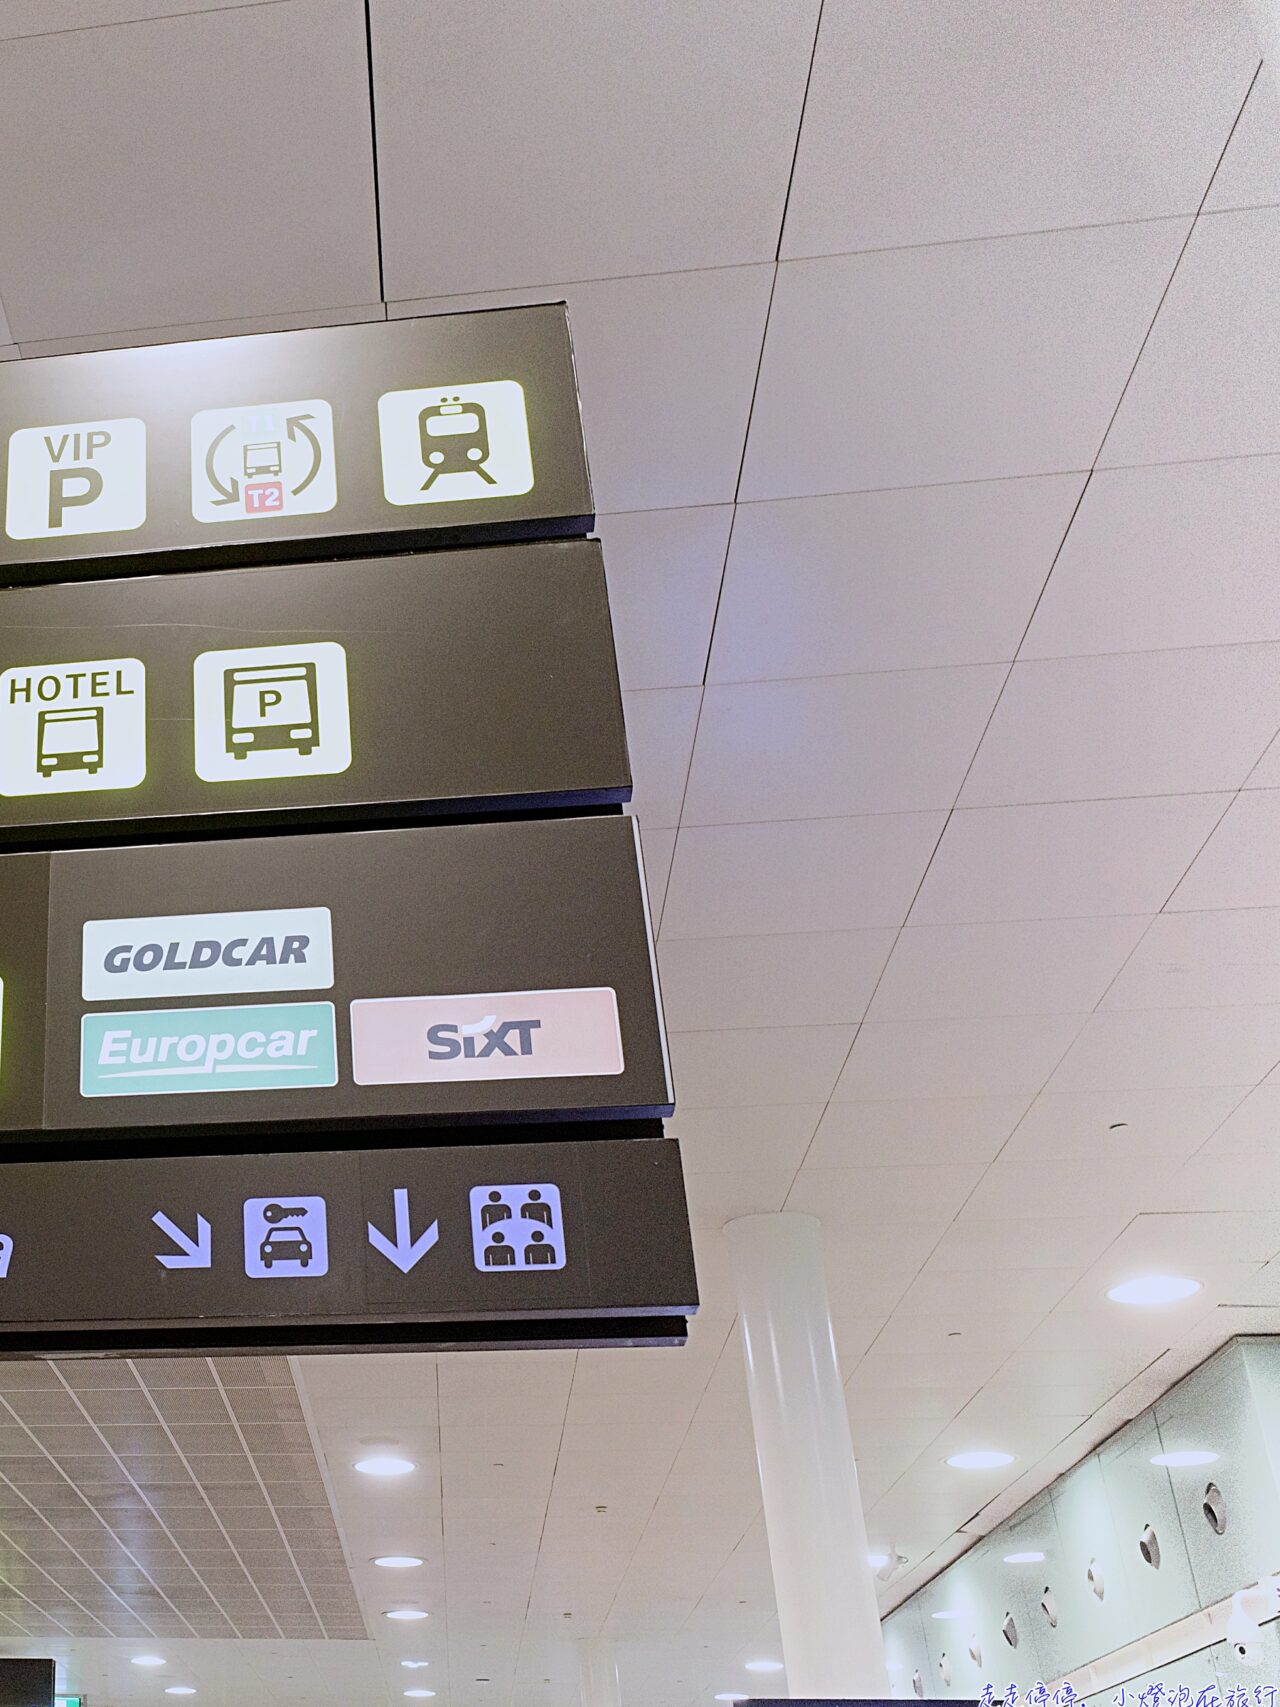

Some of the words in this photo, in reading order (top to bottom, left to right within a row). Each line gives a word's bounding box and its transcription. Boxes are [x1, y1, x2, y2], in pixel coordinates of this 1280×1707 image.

[43, 430, 112, 463] VIP
[48, 466, 104, 529] P
[248, 487, 280, 508] T2
[9, 670, 135, 704] HOTEL
[258, 689, 283, 718] P
[103, 934, 310, 974] GOLDCAR
[98, 1026, 318, 1074] Europcar
